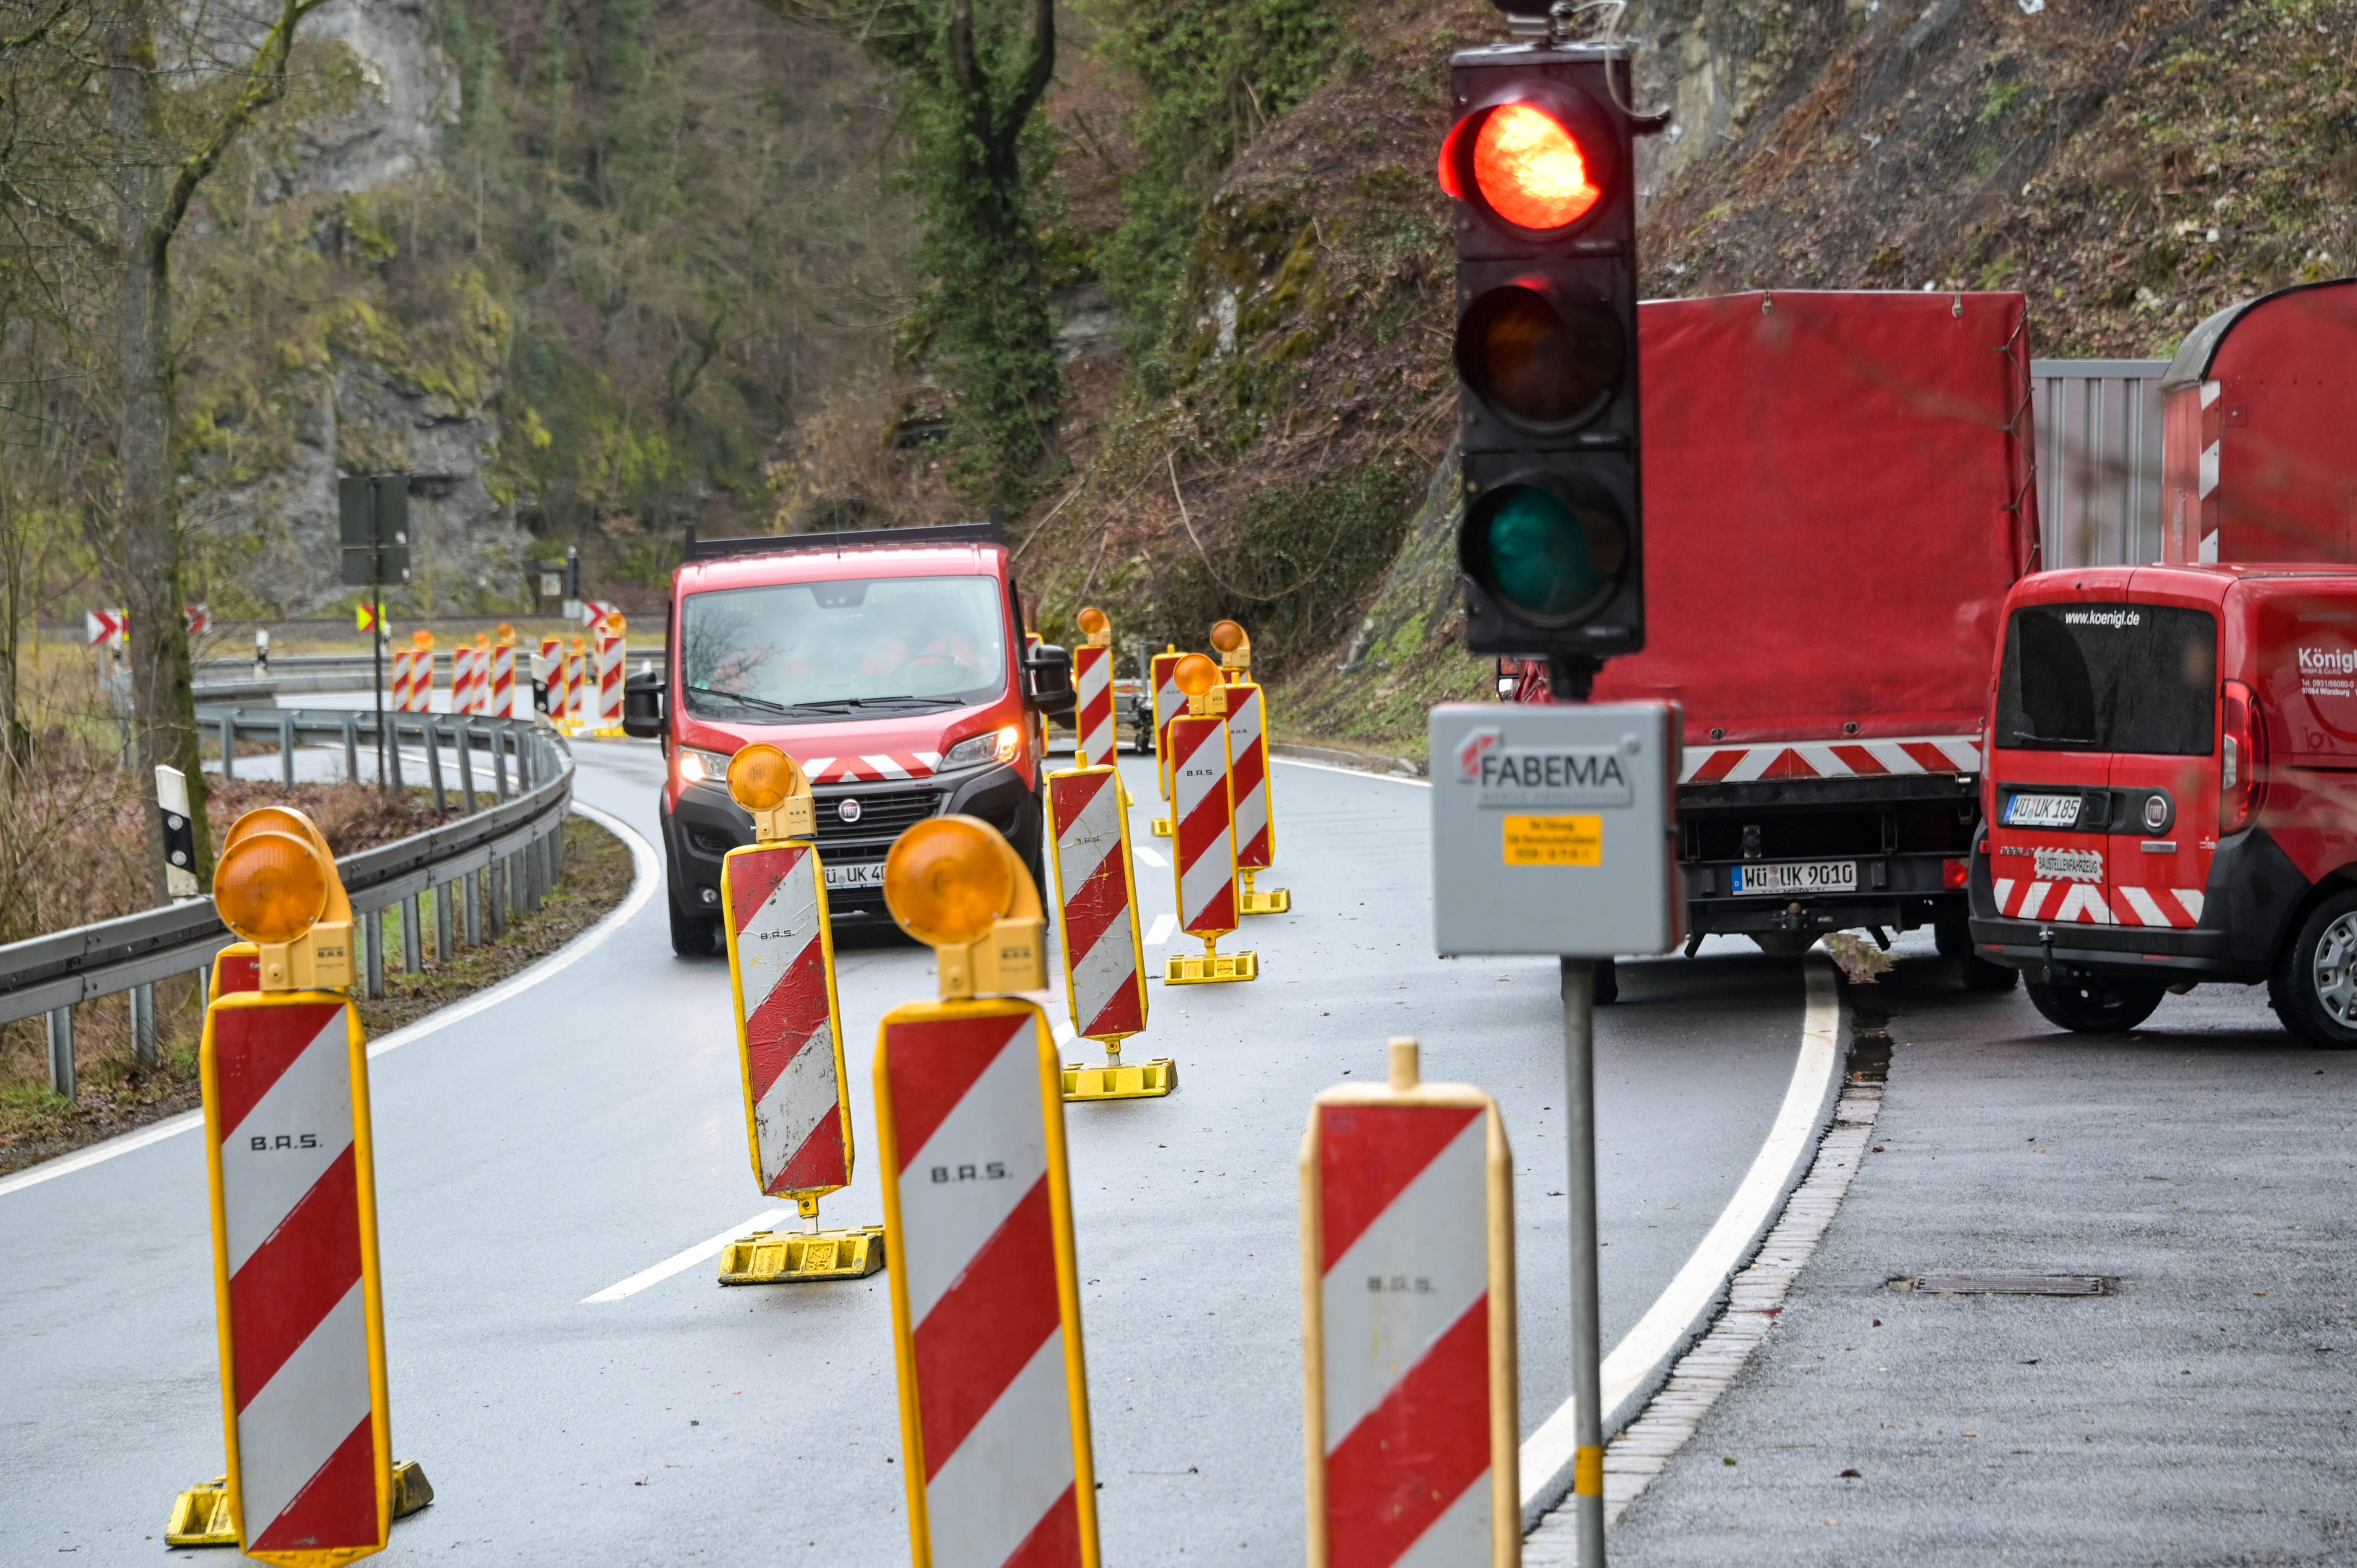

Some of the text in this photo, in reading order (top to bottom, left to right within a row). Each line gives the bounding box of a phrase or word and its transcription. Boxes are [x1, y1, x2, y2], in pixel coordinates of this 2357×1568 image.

[2065, 609, 2140, 629] www.koenigl.de
[2298, 647, 2357, 673] Königl
[1481, 756, 1624, 788] FABEMA
[843, 806, 857, 817] FIAT
[2012, 798, 2079, 819] WÜ UK 185
[2149, 805, 2162, 819] FIAT
[2038, 856, 2097, 874] BAUSTELLENFAHRZEUG
[826, 869, 836, 884] Ü
[847, 866, 867, 882] UK
[1744, 867, 1767, 888] WÜ
[1780, 866, 1802, 886] UK
[1808, 864, 1852, 885] 9010
[760, 930, 794, 940] B.A.S.
[251, 1134, 323, 1151] B.A.S.
[930, 1161, 1013, 1184] B.A.S.
